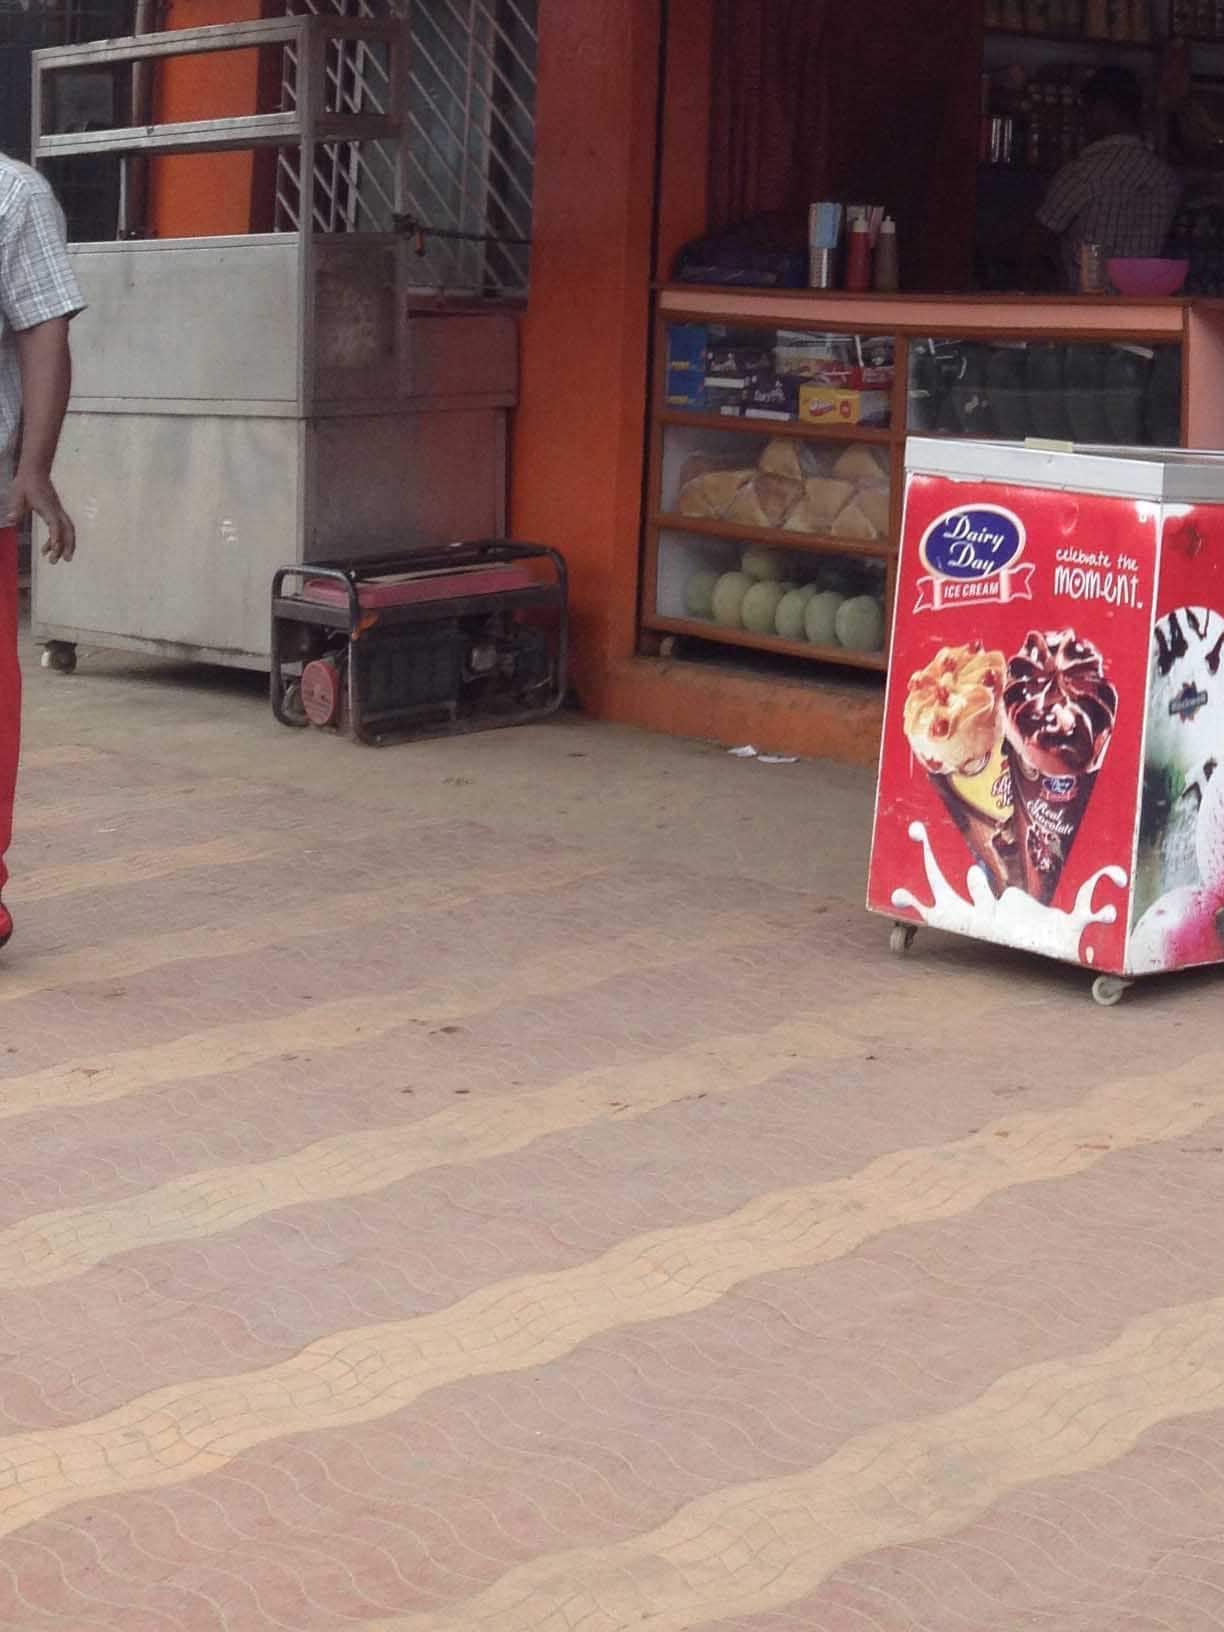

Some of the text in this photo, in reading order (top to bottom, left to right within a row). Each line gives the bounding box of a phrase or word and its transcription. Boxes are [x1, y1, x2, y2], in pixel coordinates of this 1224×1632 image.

[943, 514, 1005, 552] Dairy
[948, 541, 995, 577] Day
[1056, 546, 1138, 571] celebrate the
[944, 582, 999, 598] ICE CREAM
